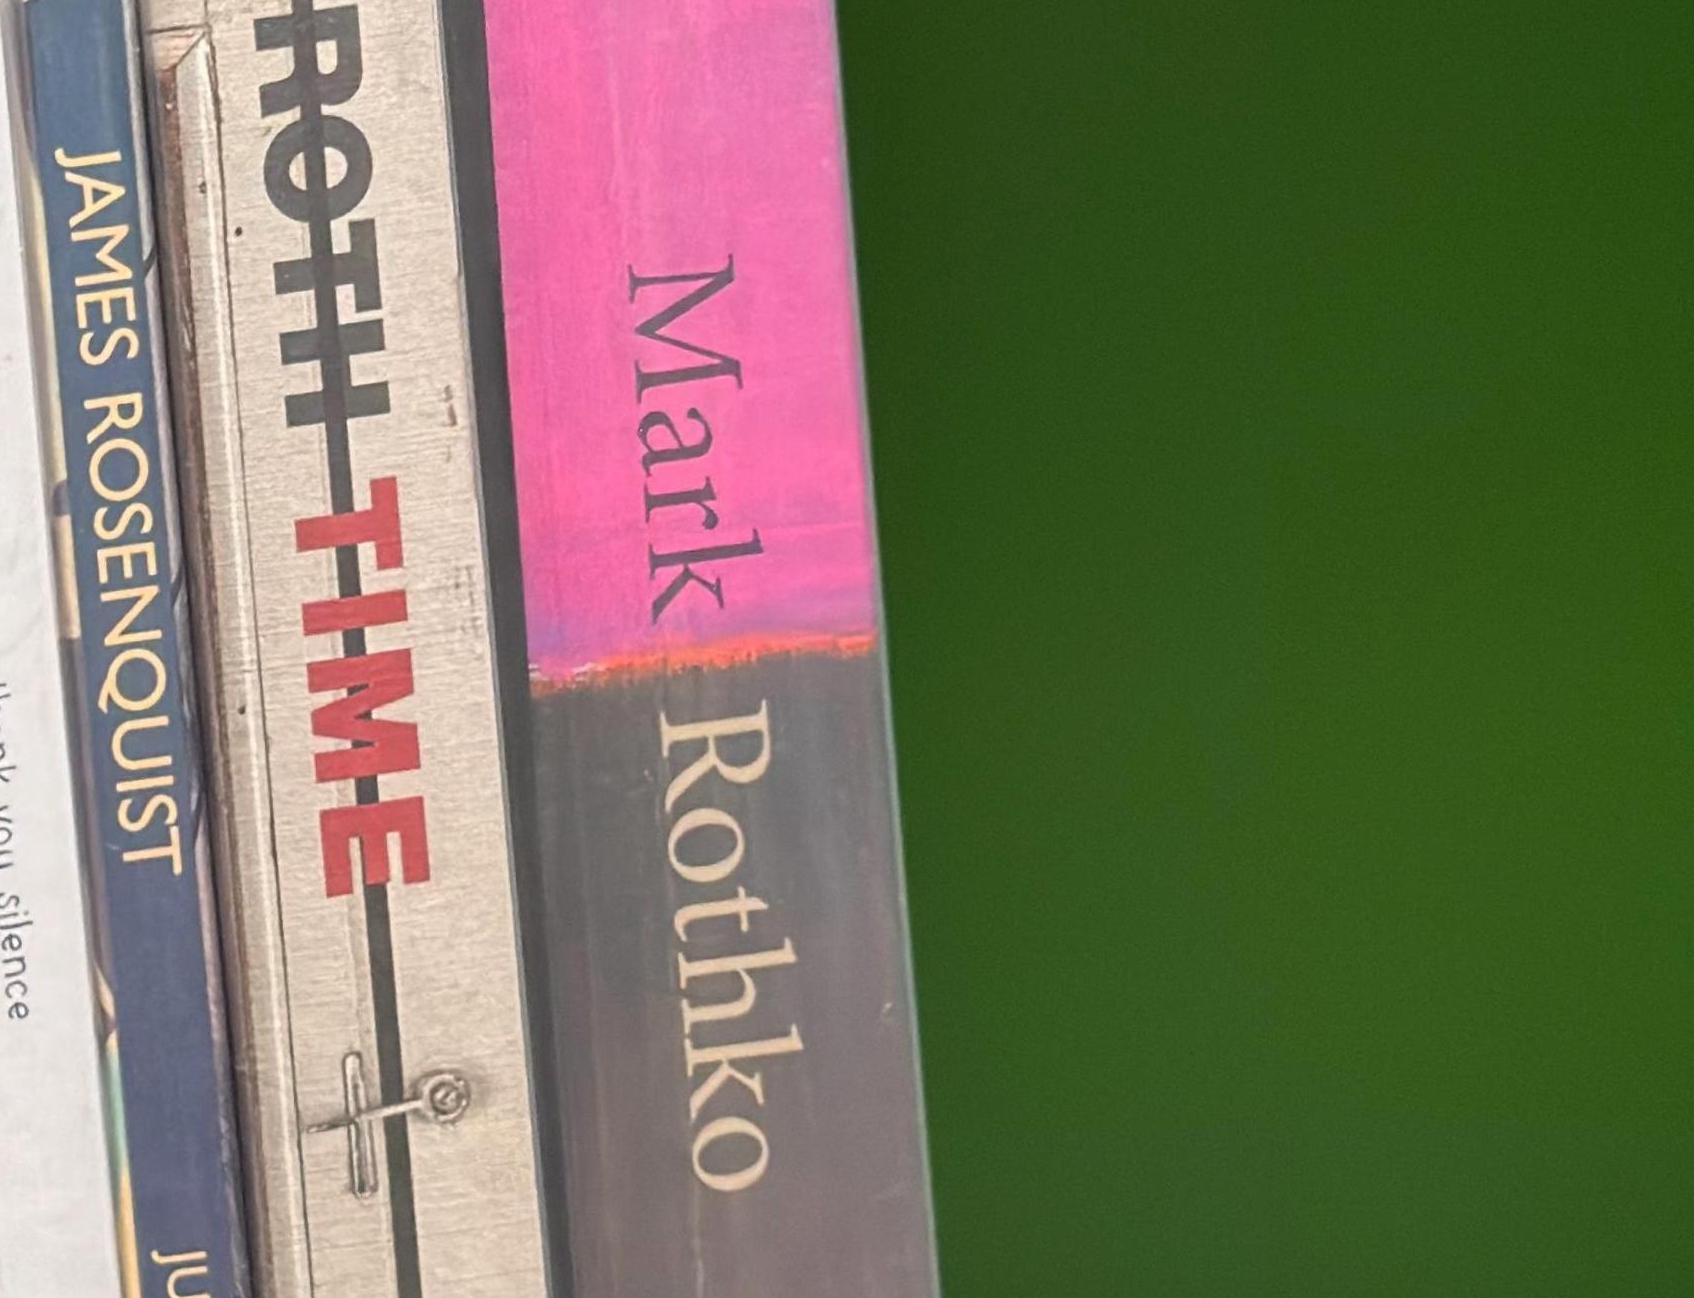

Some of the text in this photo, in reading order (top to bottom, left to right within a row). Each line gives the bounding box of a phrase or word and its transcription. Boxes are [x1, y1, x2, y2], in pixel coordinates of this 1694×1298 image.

[54, 148, 182, 876] JAMES ROSENQUIST
[254, 5, 430, 898] ROTH TIME
[628, 253, 805, 1192] Mark Rothko
